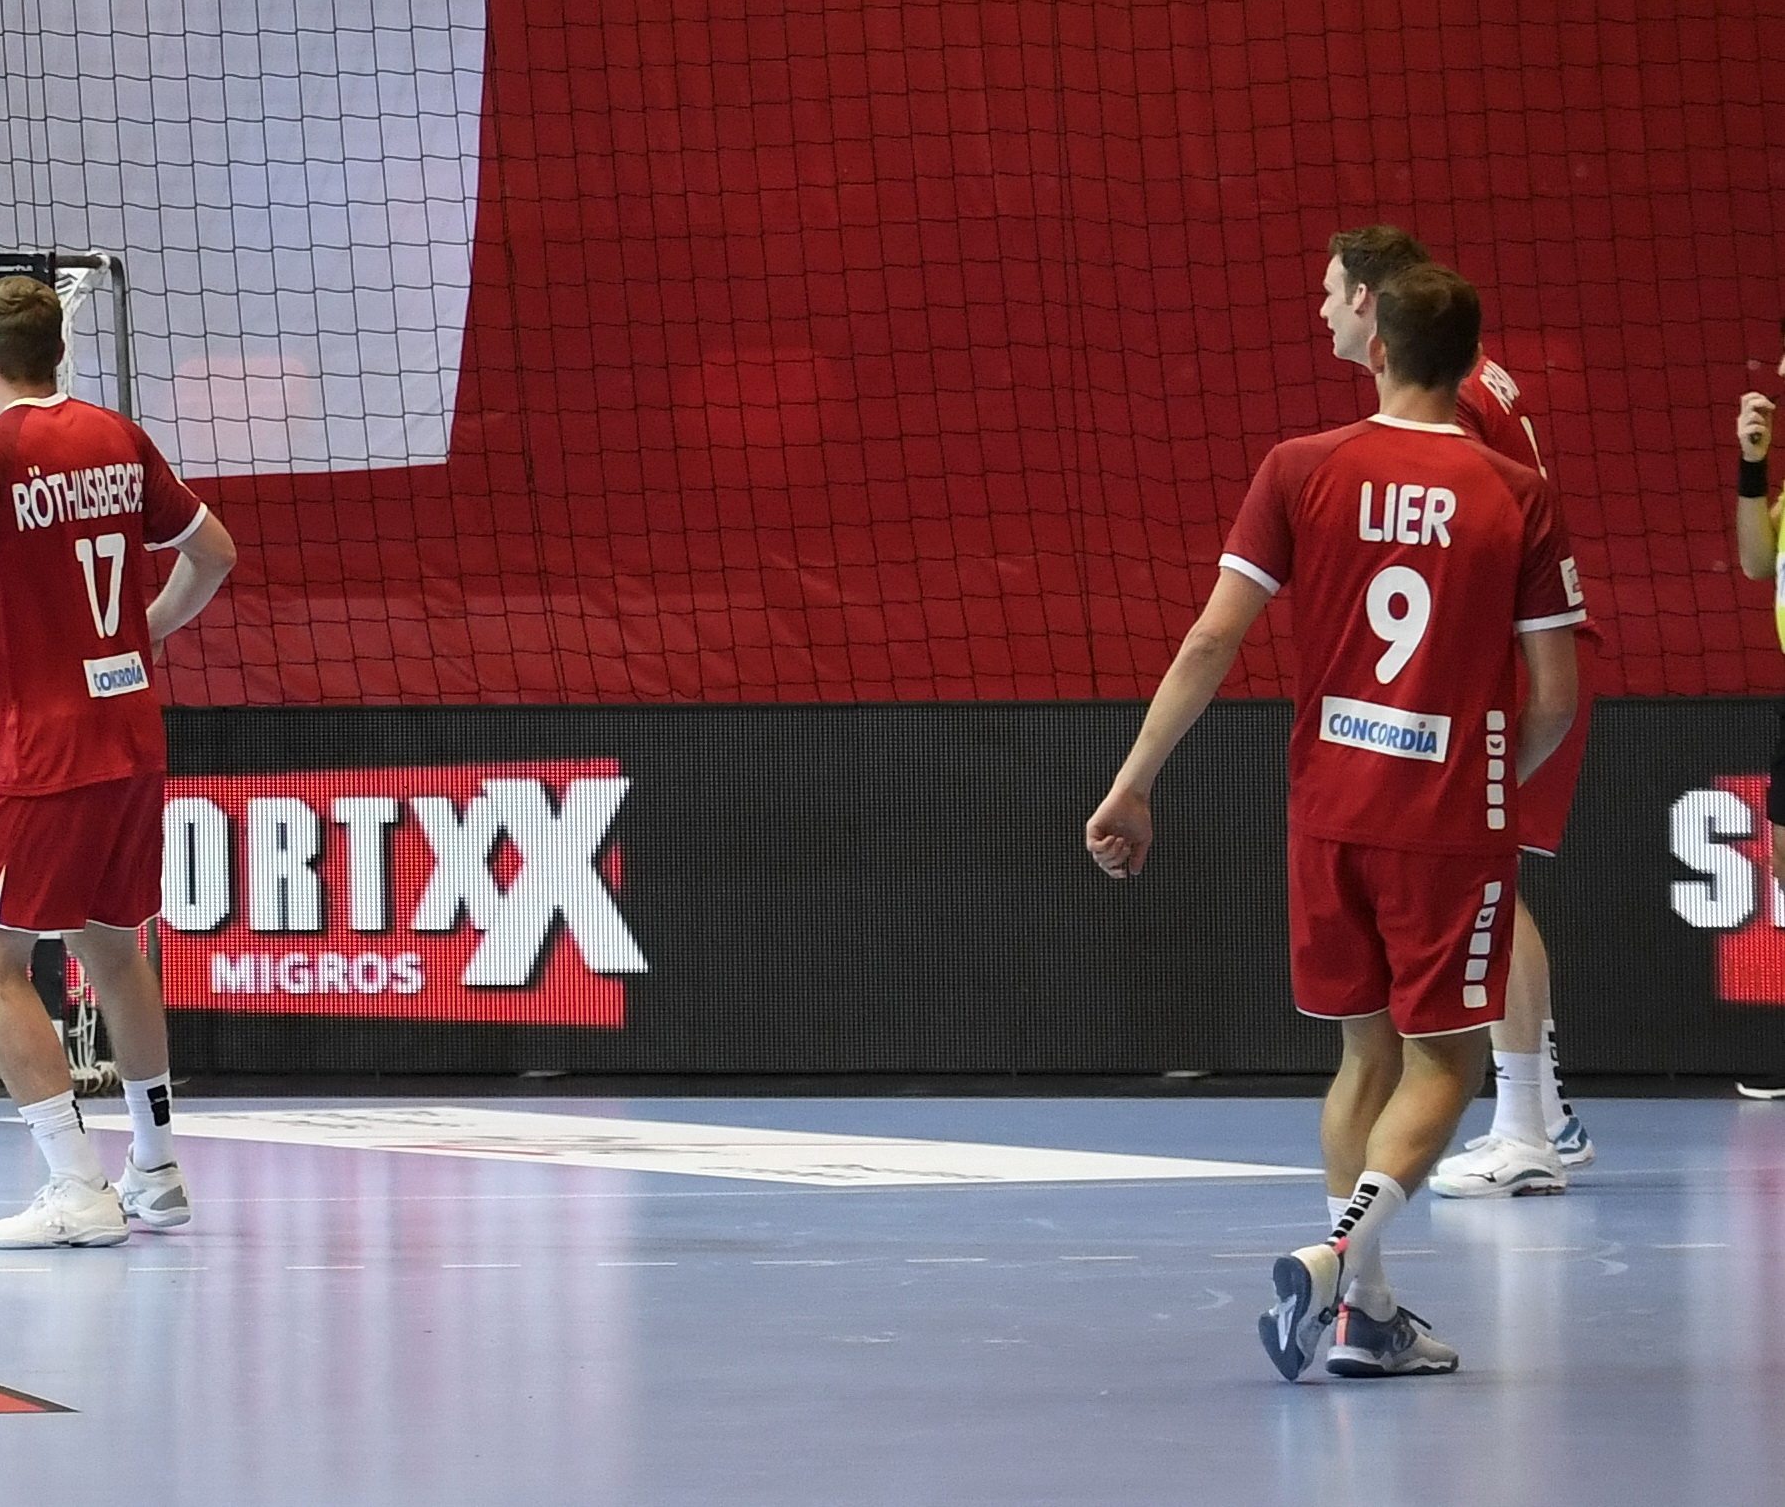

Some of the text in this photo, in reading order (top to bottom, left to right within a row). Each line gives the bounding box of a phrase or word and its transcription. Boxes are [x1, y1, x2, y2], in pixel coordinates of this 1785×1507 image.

[1358, 481, 1456, 549] LIER
[75, 532, 126, 639] 17
[1366, 565, 1432, 685] 9
[1328, 714, 1438, 755] CONCORDIA
[161, 776, 649, 986] ORTXX
[1669, 791, 1785, 927] S
[211, 952, 425, 995] MIGROS
